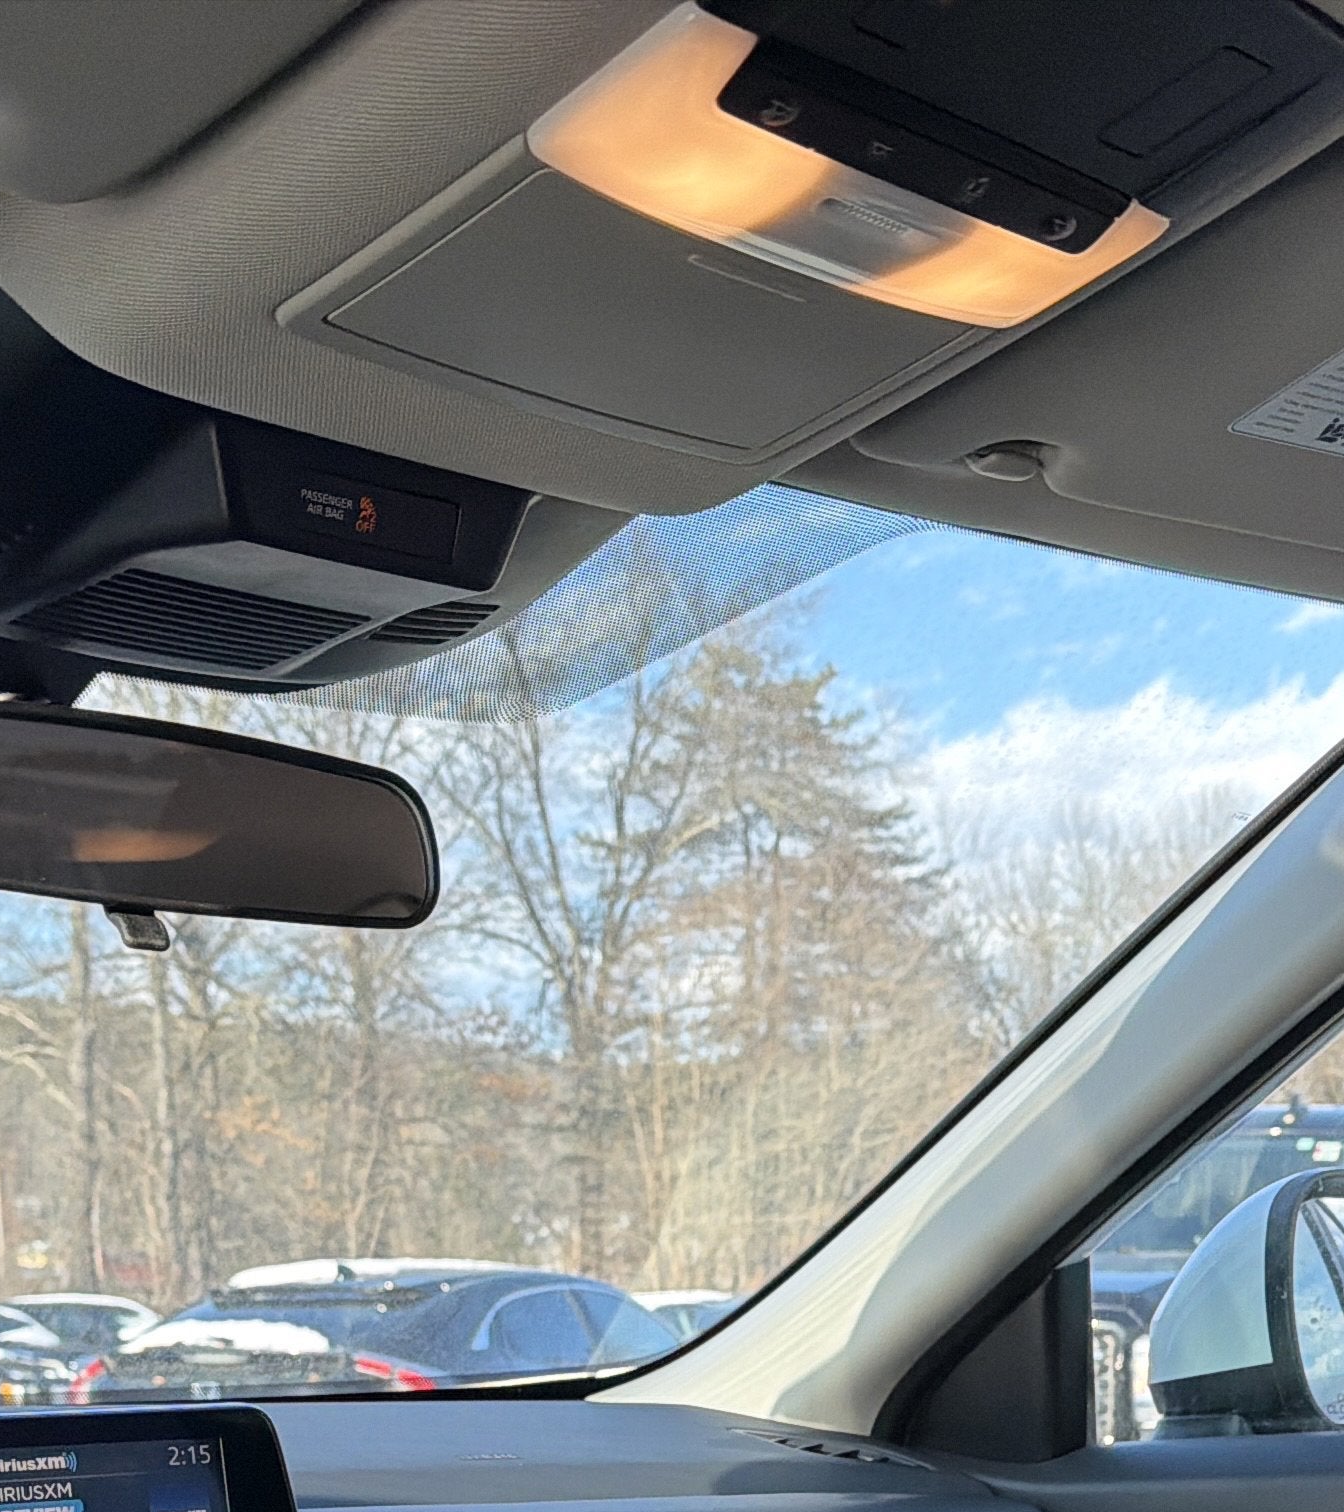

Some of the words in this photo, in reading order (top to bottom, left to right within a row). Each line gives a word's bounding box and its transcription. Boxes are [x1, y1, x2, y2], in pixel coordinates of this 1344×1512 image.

[300, 488, 353, 510] PASSENGER
[306, 502, 323, 515] AIR
[324, 506, 345, 521] BAG
[355, 519, 377, 533] OFF
[167, 1444, 212, 1467] 2:15
